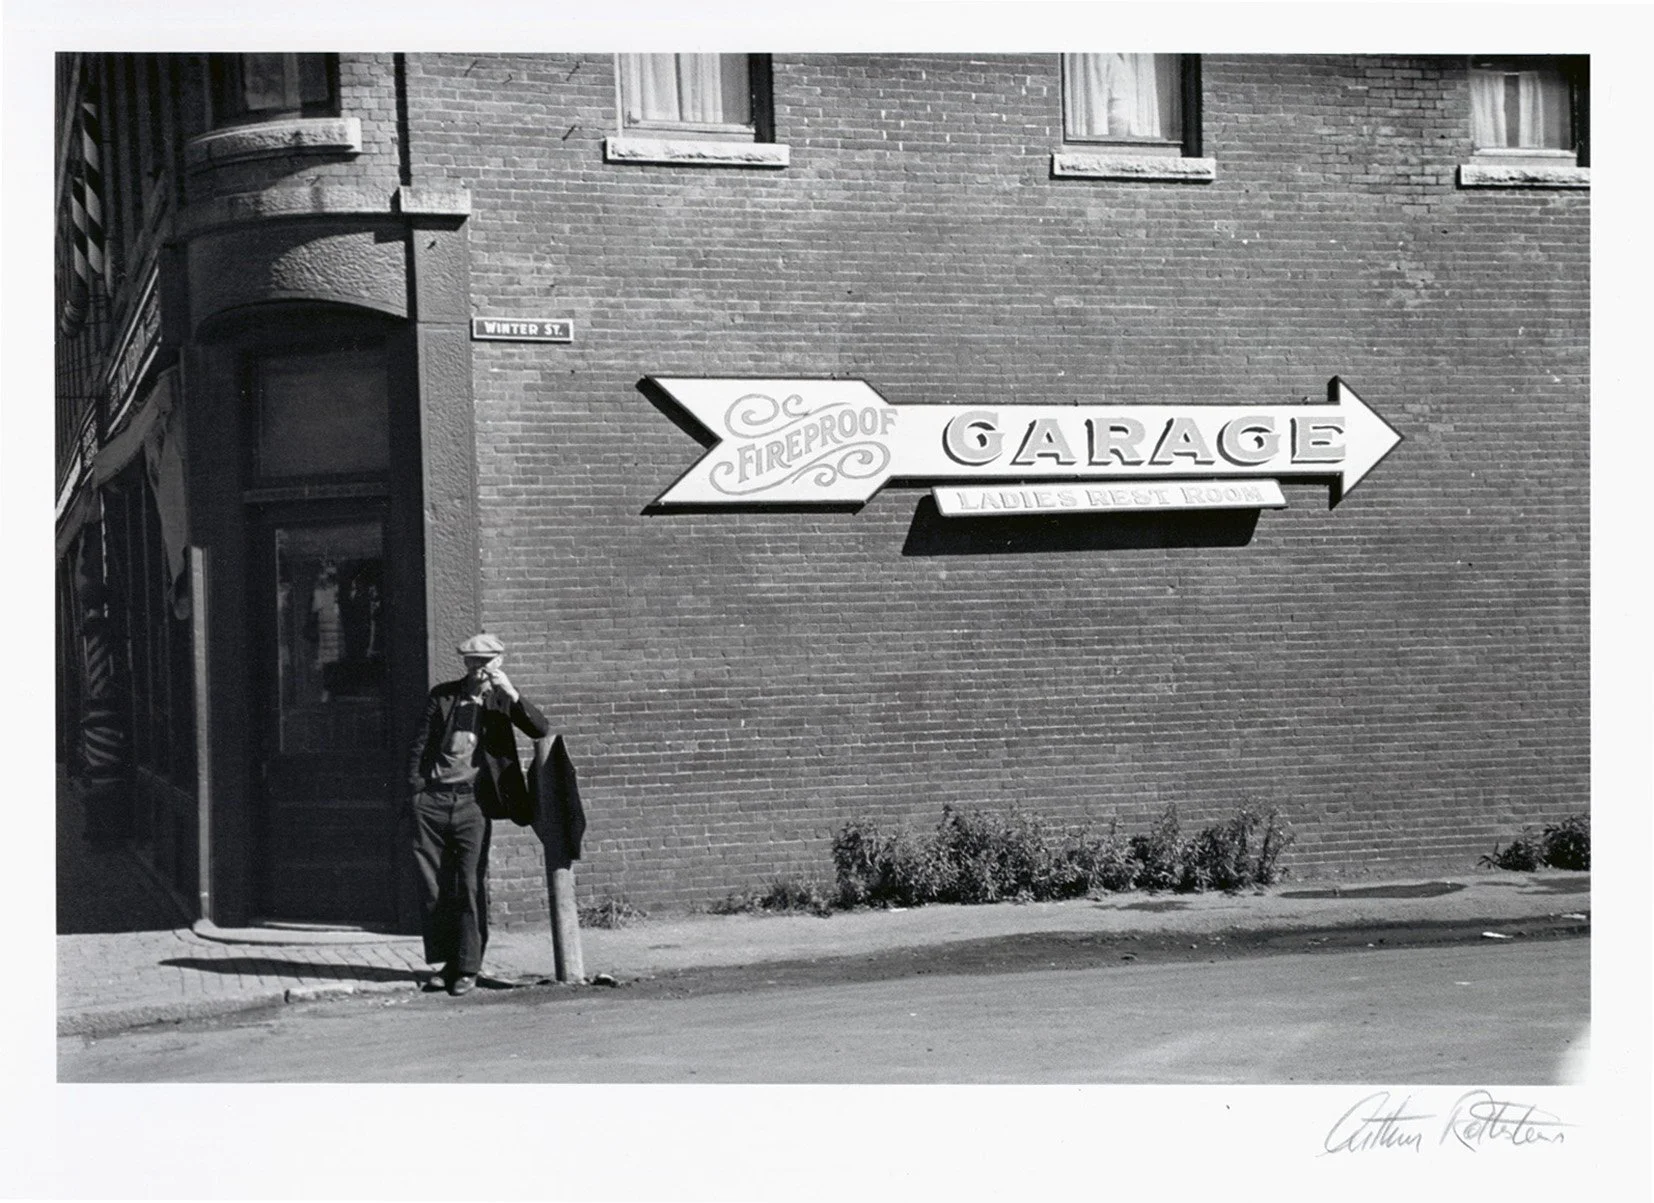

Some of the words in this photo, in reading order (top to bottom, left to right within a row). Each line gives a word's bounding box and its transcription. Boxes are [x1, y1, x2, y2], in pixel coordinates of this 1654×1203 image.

[484, 321, 539, 335] WINTER
[544, 323, 563, 336] ST.
[737, 407, 898, 484] FIREPROOF
[942, 411, 1346, 467] GARAGE
[956, 488, 1078, 510] LADIES
[1085, 486, 1171, 507] REST
[1179, 484, 1263, 504] ROOM
